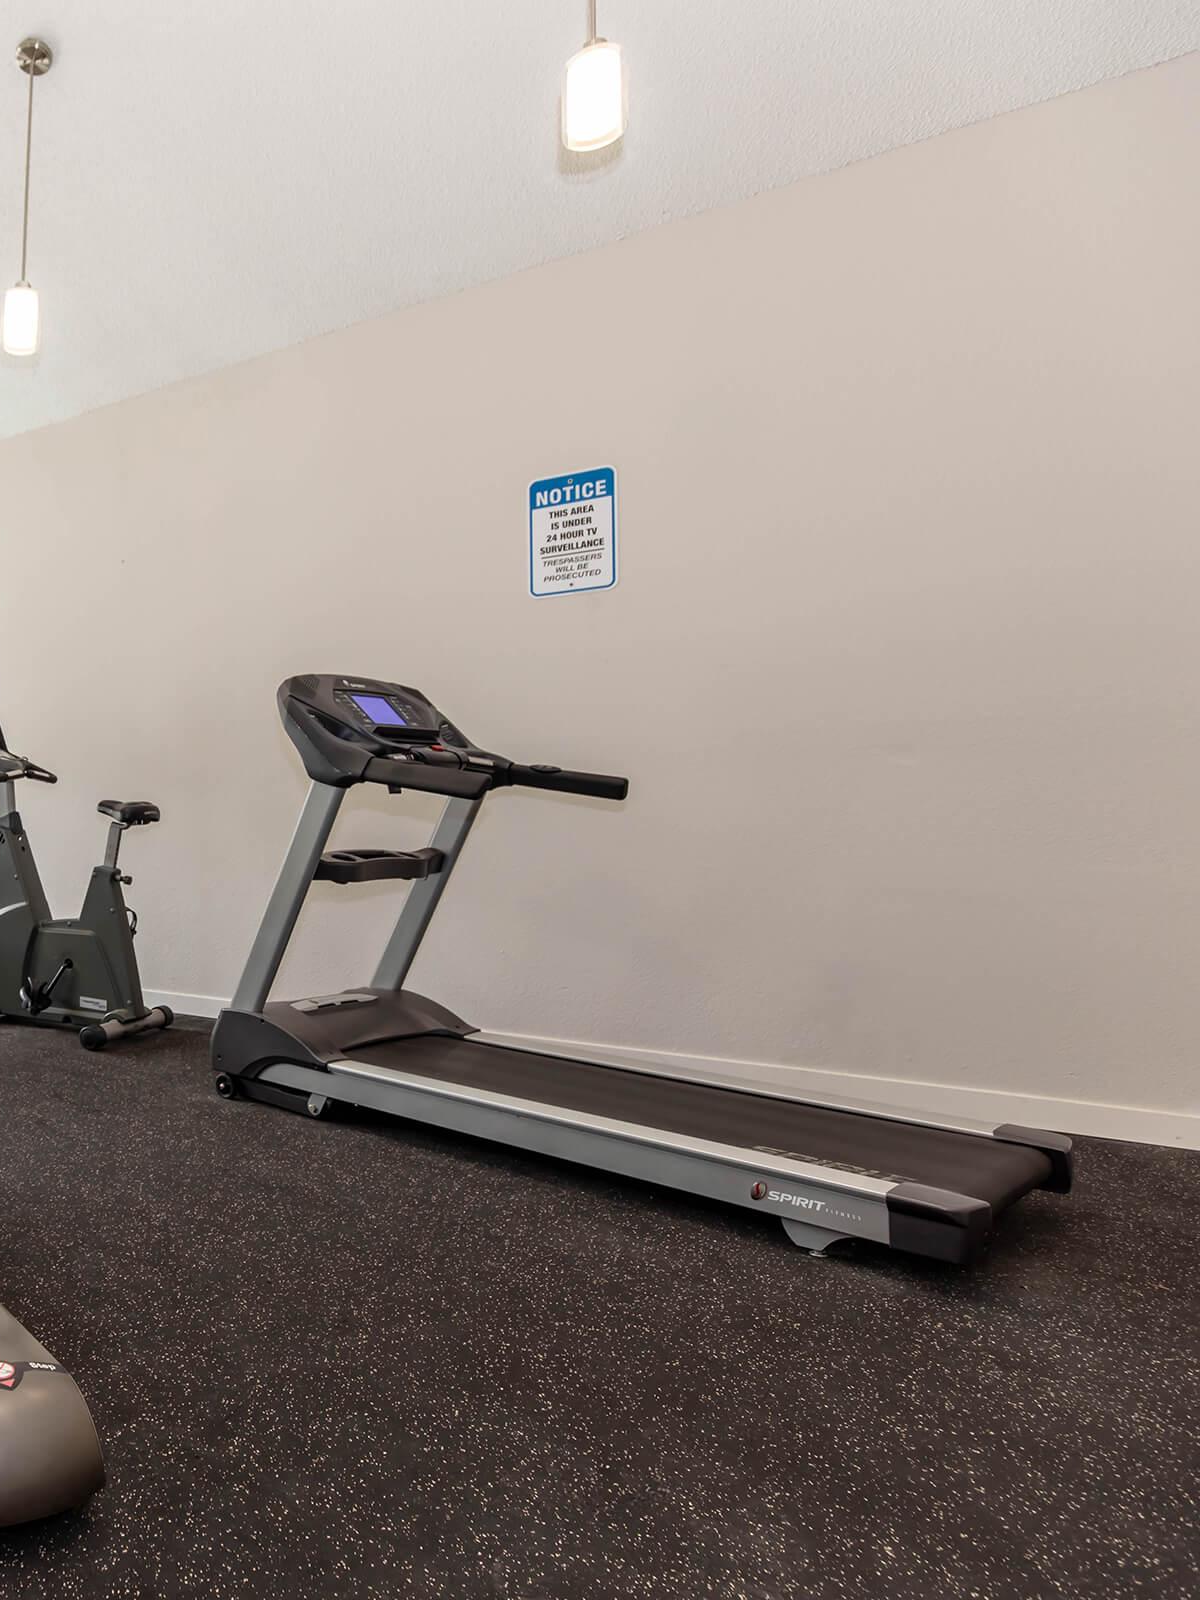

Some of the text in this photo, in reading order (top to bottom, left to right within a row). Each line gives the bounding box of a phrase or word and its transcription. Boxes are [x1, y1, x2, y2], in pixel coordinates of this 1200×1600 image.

[535, 480, 607, 507] NOTICE
[549, 504, 594, 519] THIS AREA
[551, 516, 592, 530] IS UNDER
[546, 527, 598, 542] 24 HOUR TV
[540, 538, 604, 555] SURVEILLANCE
[543, 552, 602, 567] TRESPASSERS
[556, 562, 589, 573] WILL BE
[544, 569, 602, 582] PROSECUTED
[767, 1191, 826, 1211] SPIRIT
[29, 1362, 57, 1372] Step
